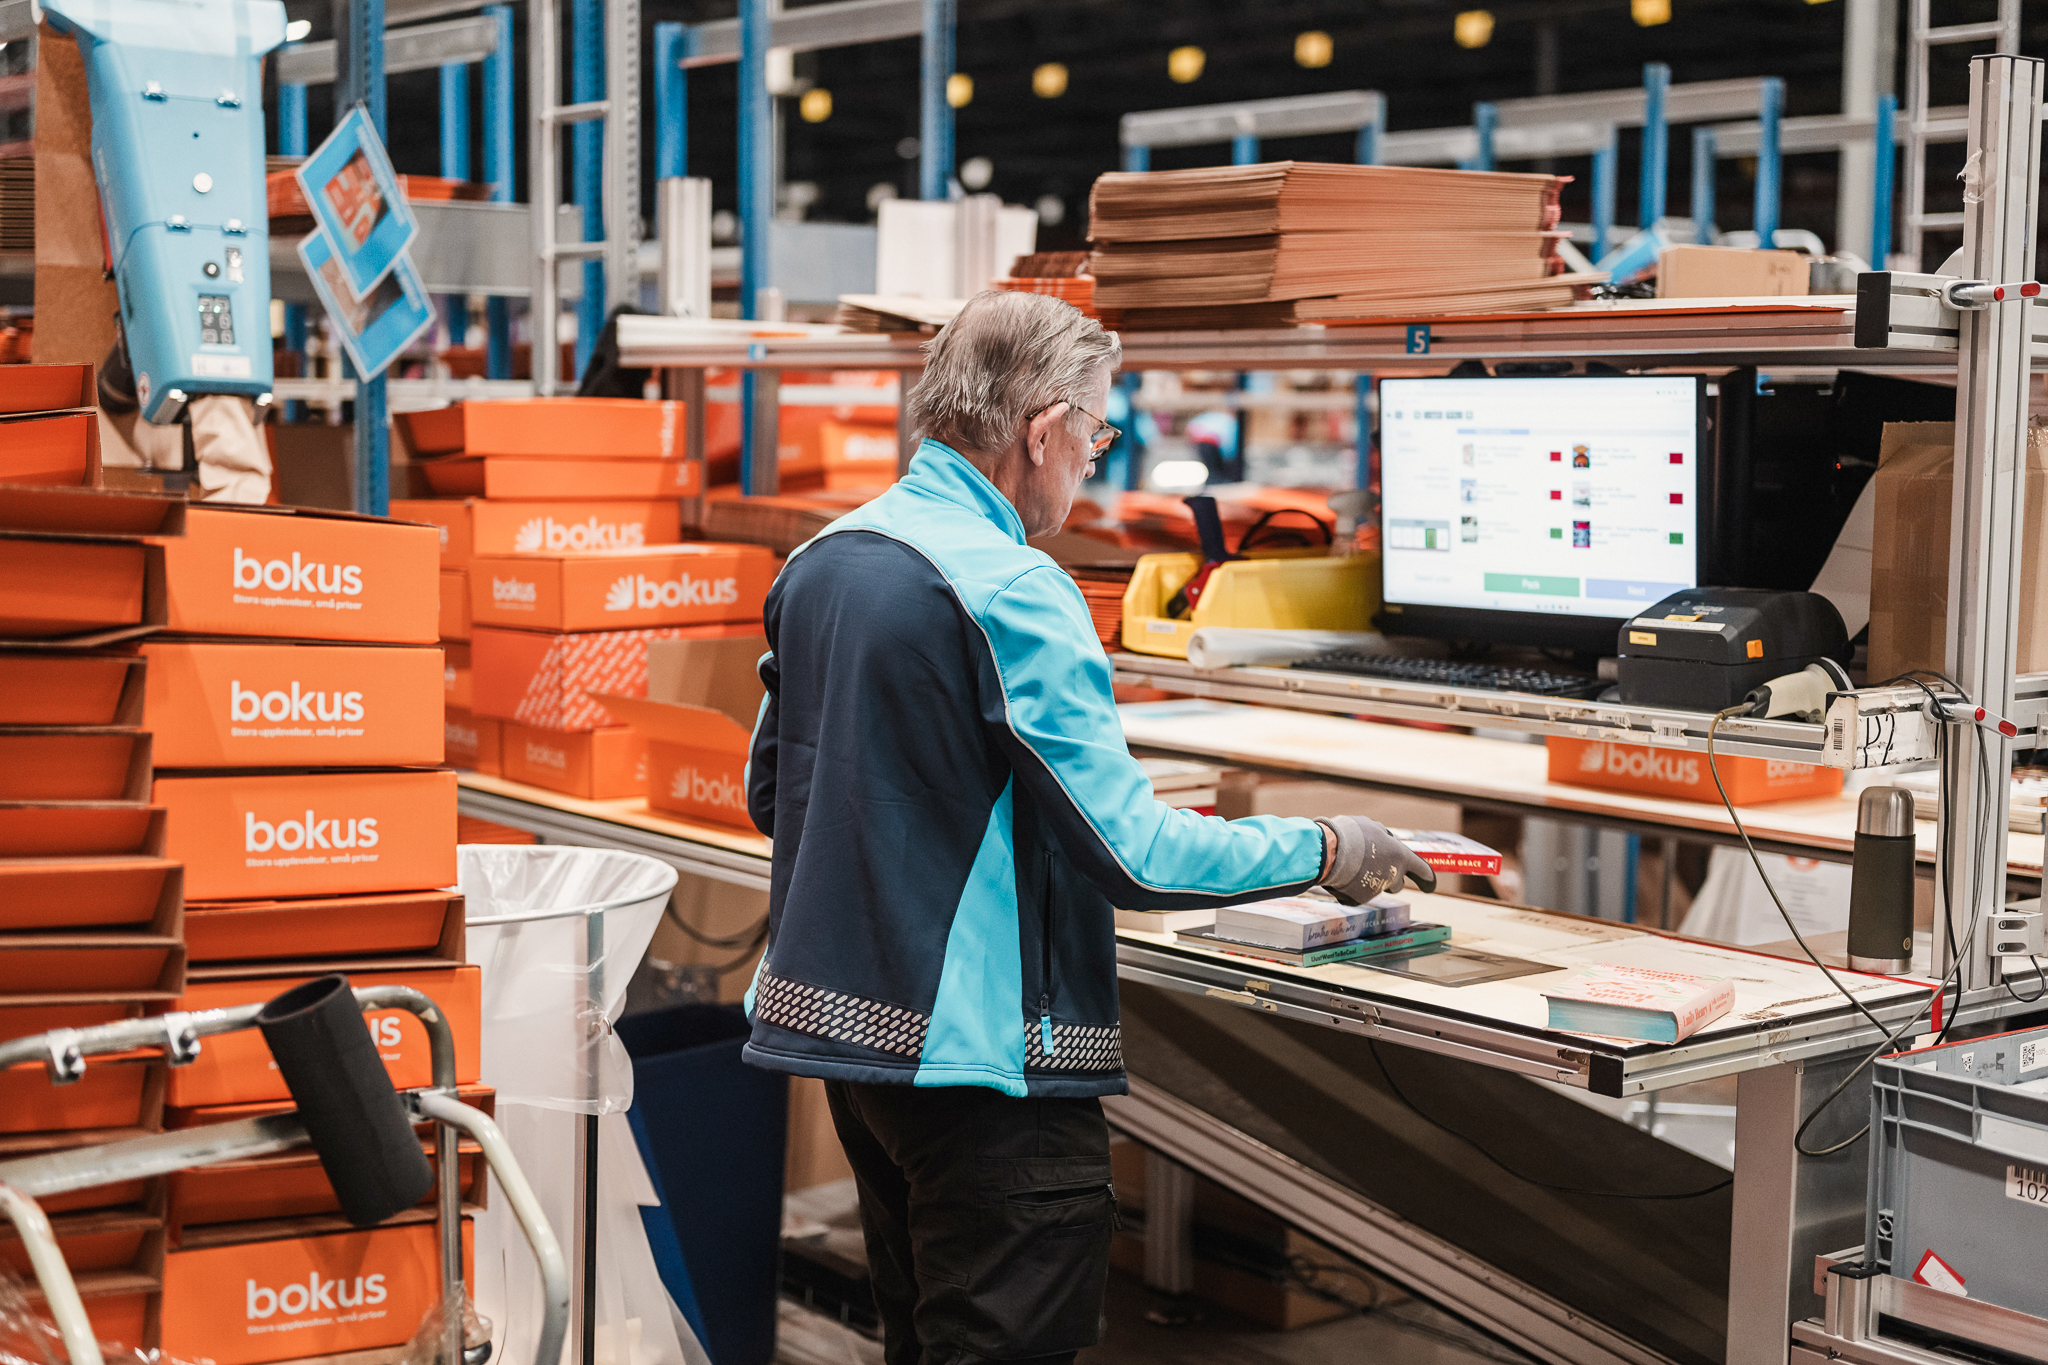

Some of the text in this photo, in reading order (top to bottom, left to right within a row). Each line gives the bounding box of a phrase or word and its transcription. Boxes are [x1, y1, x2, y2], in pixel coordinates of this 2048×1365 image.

[1413, 330, 1426, 353] 5
[545, 515, 645, 551] bokus
[233, 546, 363, 596] bokus
[636, 572, 739, 608] bokus
[231, 680, 365, 722] bokus
[1607, 743, 1700, 785] bokus
[691, 768, 749, 811] boku
[245, 809, 380, 853] bokus
[1457, 859, 1482, 867] GRACE
[1308, 924, 1330, 942] breathe
[246, 1271, 388, 1320] bokus
